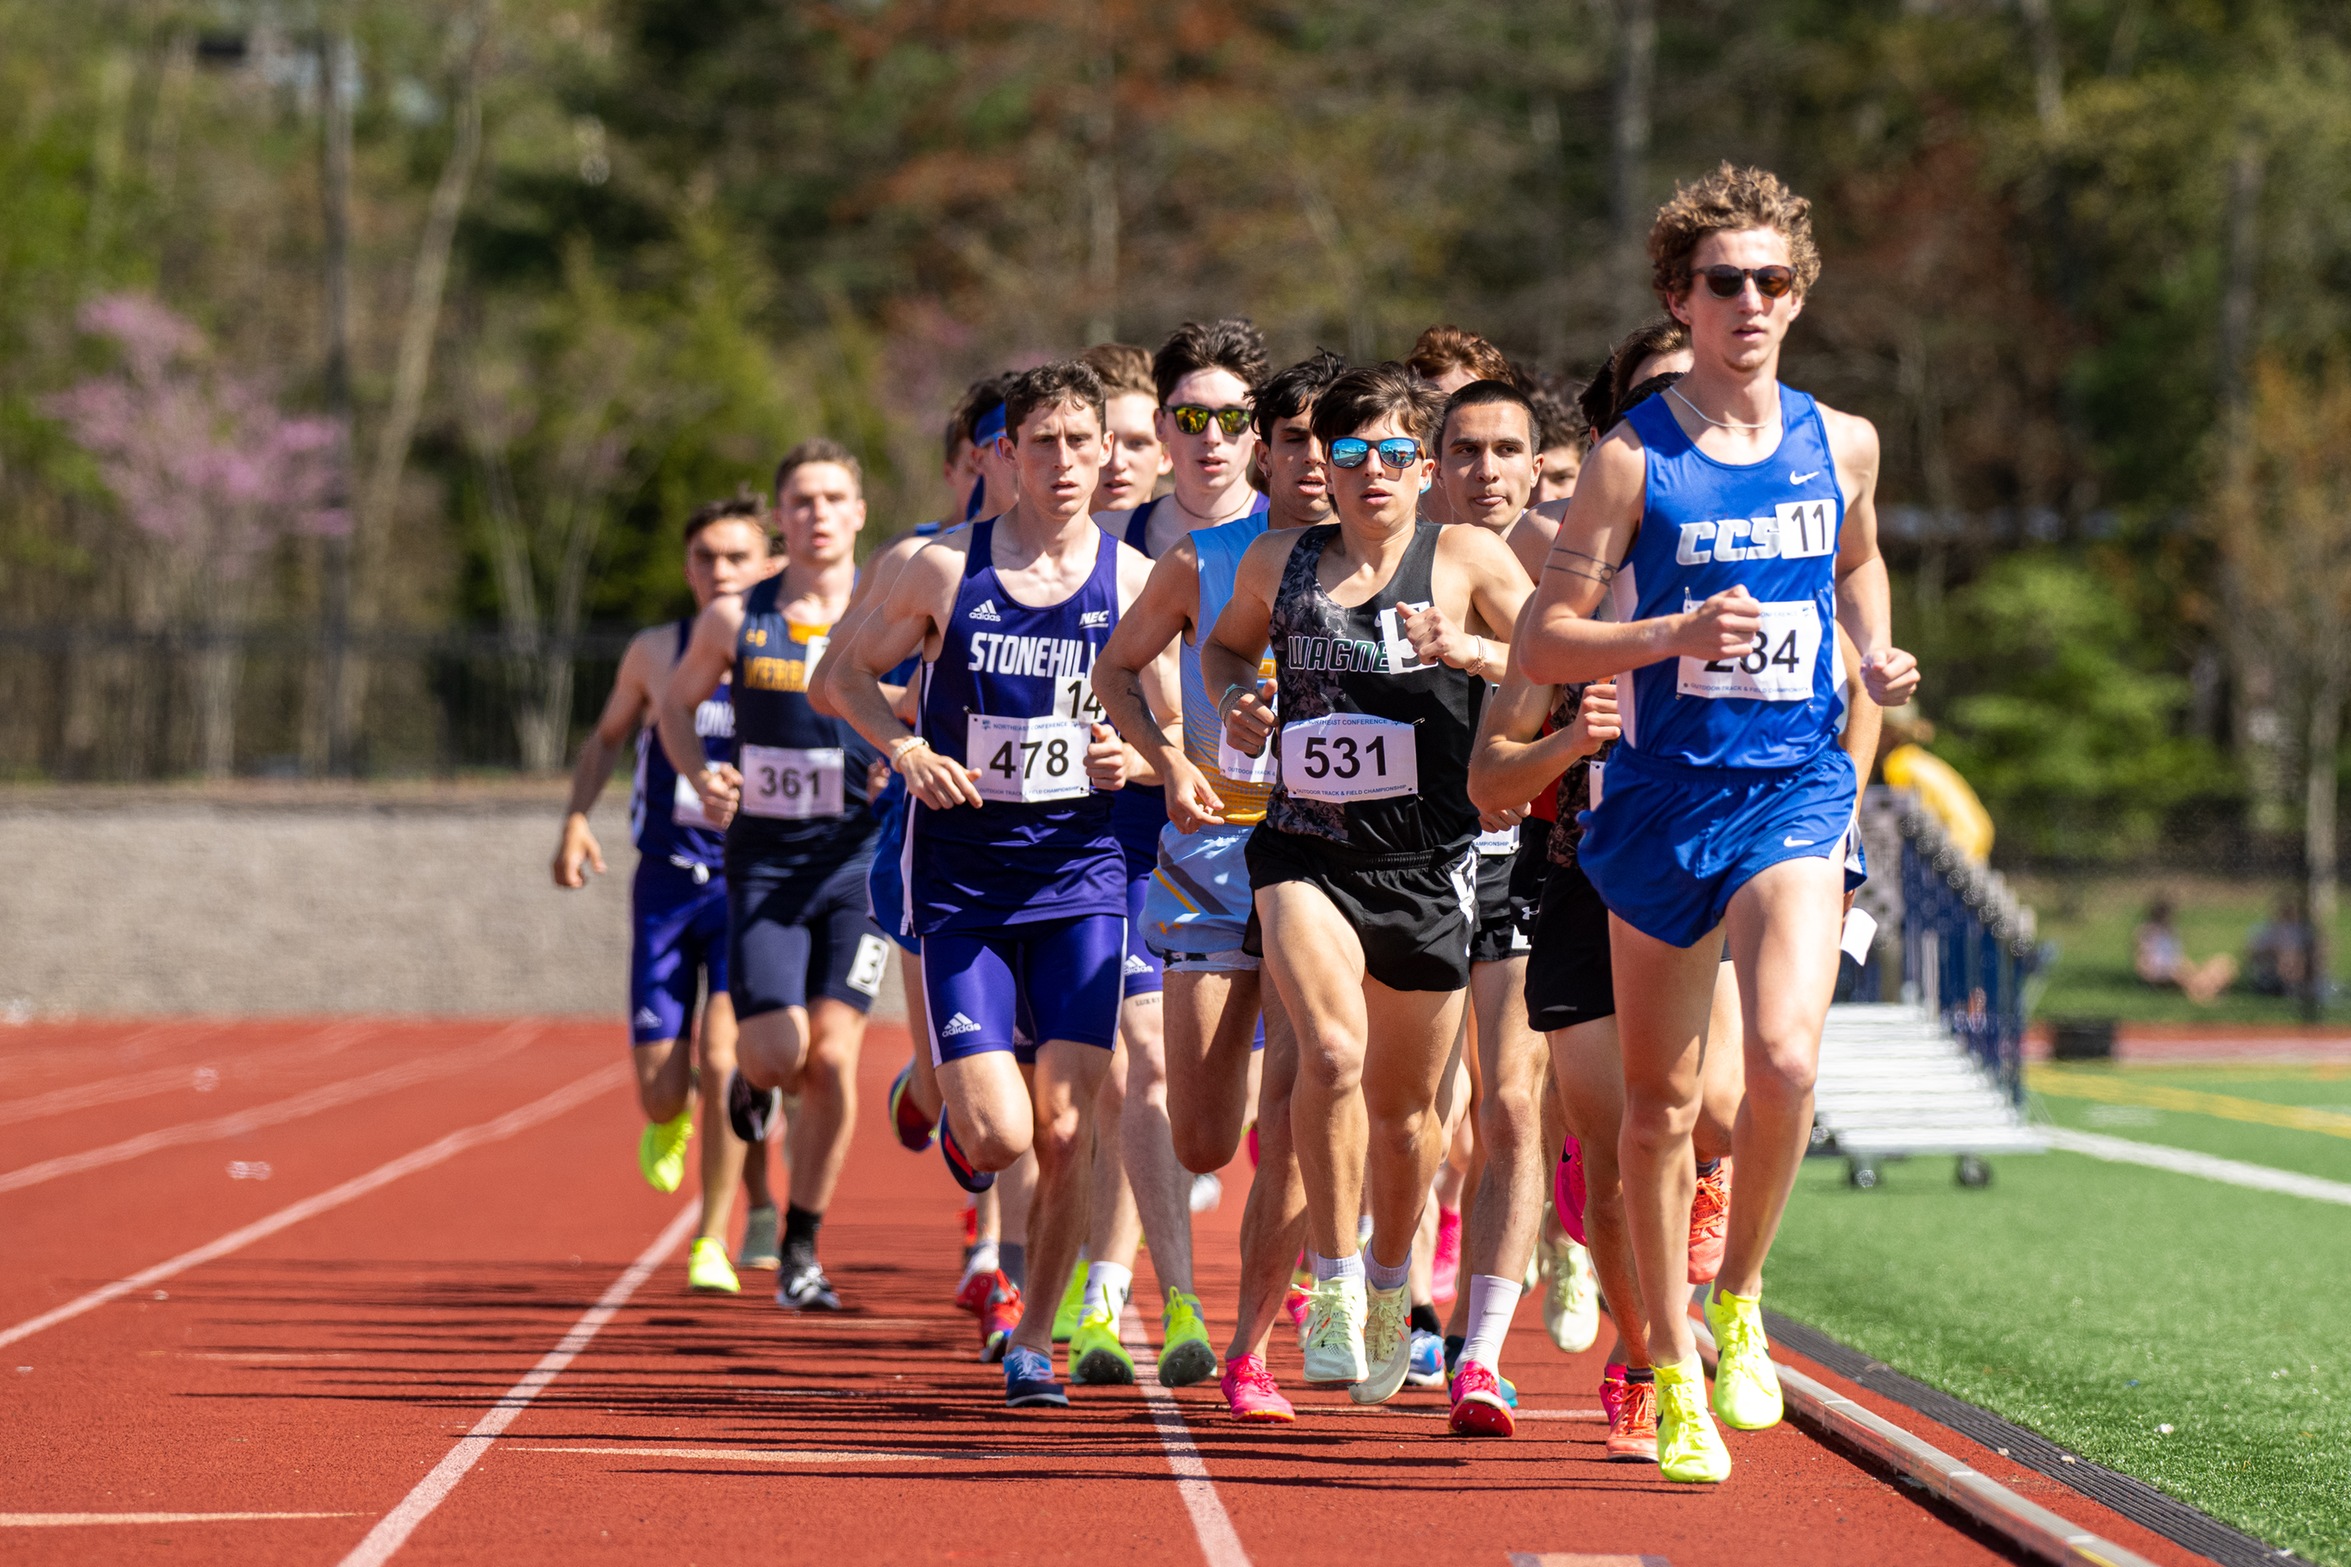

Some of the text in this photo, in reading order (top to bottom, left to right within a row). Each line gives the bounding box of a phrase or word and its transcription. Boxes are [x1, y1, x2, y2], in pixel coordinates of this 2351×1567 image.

[1790, 503, 1826, 552] 11
[968, 611, 1001, 622] adidas
[1079, 610, 1110, 626] NEC
[1067, 680, 1103, 719] 14
[1342, 718, 1388, 726] CONFERENCE
[989, 738, 1070, 780] 478
[1304, 735, 1387, 779] 531
[1228, 766, 1253, 776] OUTDOOR
[1254, 769, 1272, 777] TRACK
[758, 766, 820, 799] 361
[1043, 785, 1080, 794] CHAMPIONSHIP
[1297, 788, 1321, 796] OUTDOOR
[1341, 788, 1346, 796] &
[1346, 787, 1363, 795] FIELD
[1364, 784, 1408, 794] CHAMPIONSHIP
[860, 943, 883, 986] 3
[941, 1022, 982, 1038] adidas
